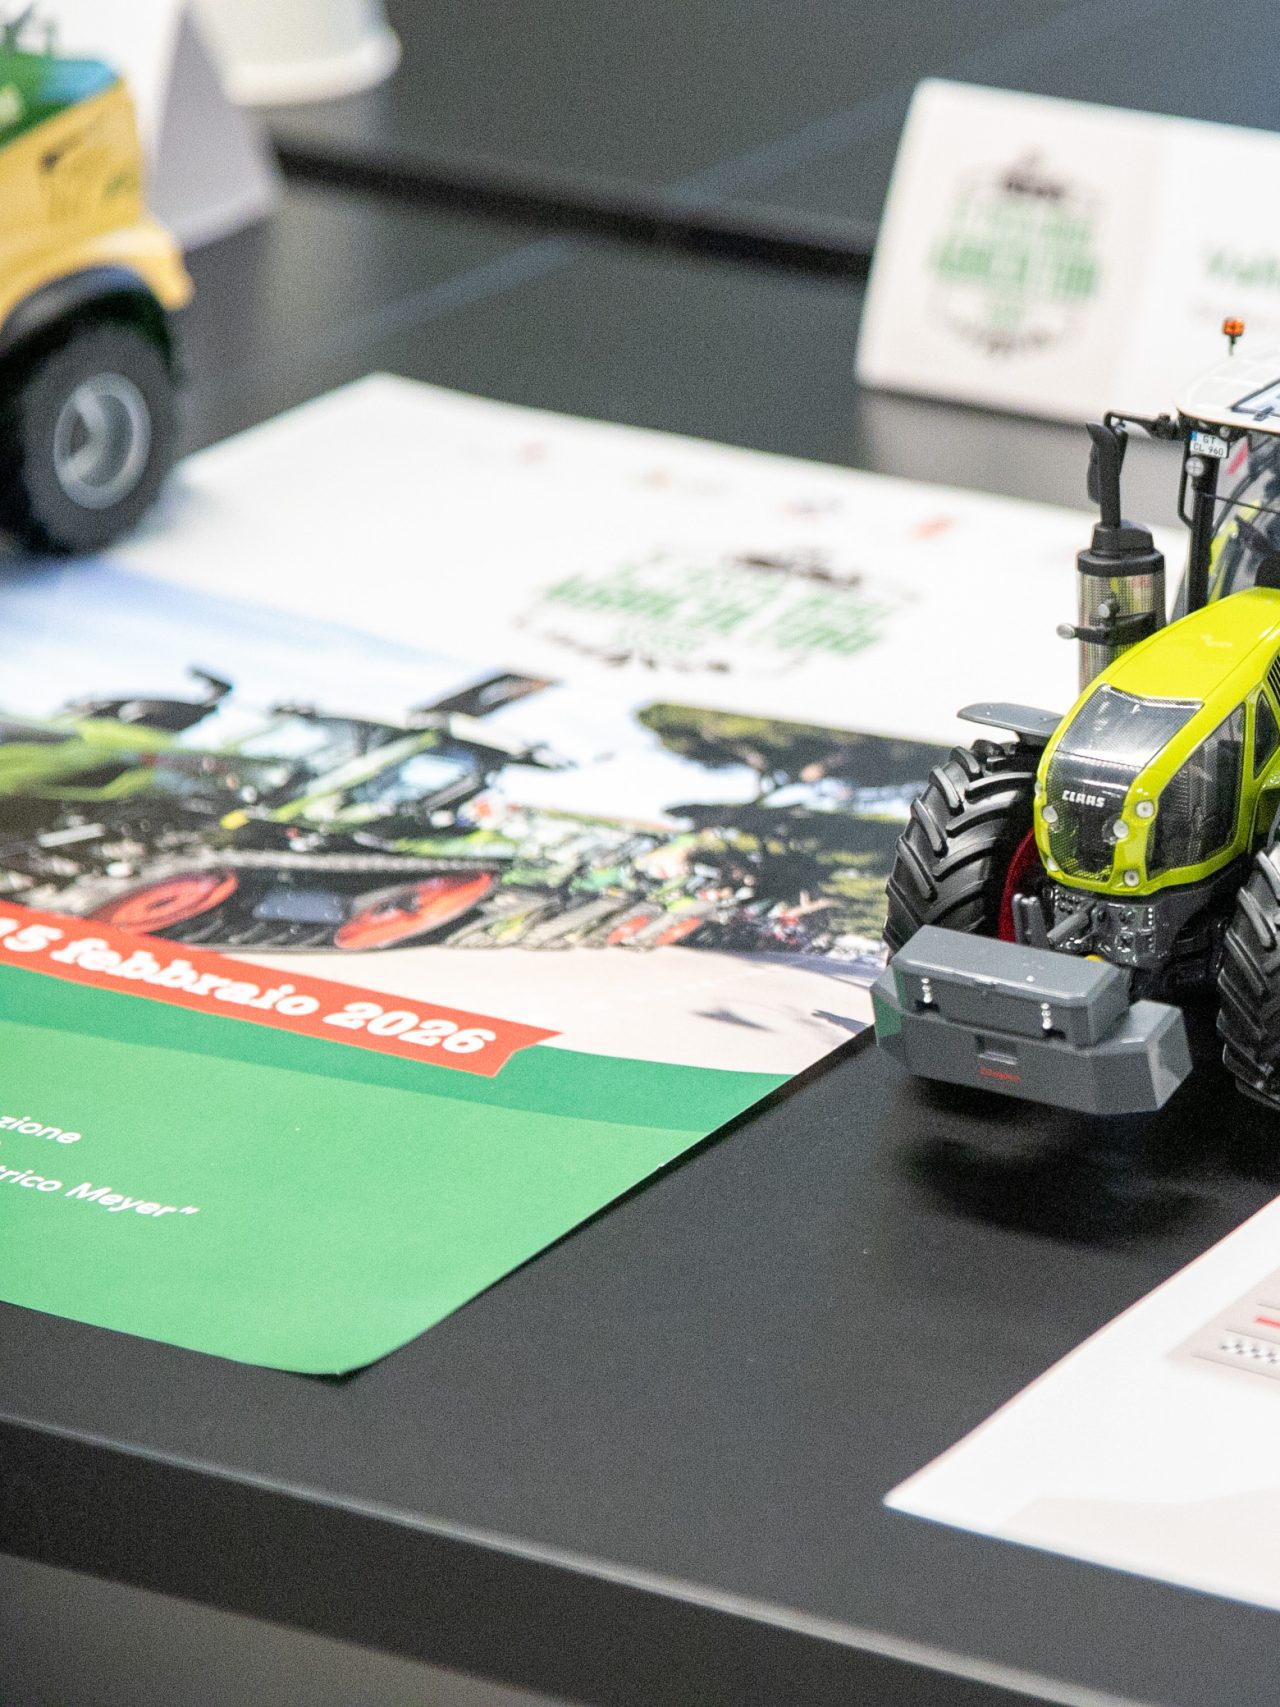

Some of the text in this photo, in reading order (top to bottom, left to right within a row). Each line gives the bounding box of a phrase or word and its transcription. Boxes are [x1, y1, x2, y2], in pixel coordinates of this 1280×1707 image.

[1062, 790, 1106, 808] CLAAS
[50, 937, 320, 1016] febbraio
[322, 1002, 496, 1053] 2026
